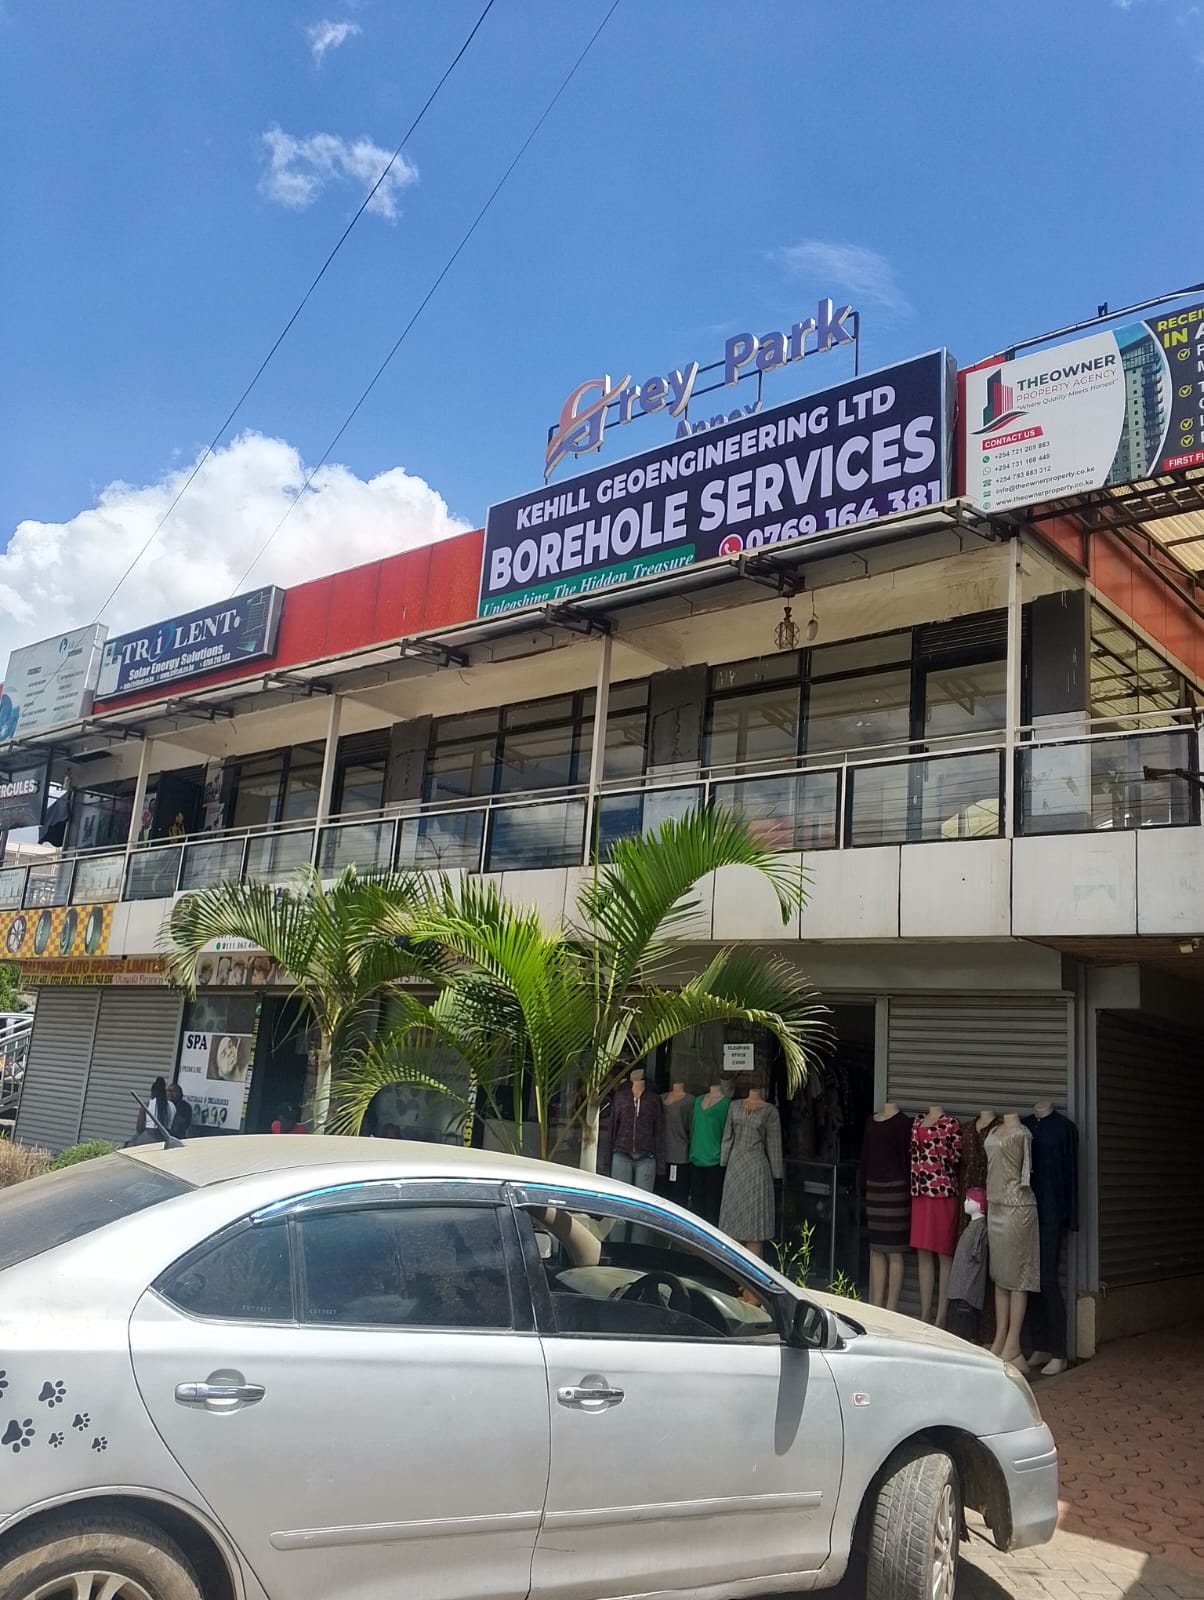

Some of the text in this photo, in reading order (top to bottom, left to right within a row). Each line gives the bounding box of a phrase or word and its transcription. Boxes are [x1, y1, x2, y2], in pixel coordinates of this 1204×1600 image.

[1158, 309, 1204, 332] RECEI
[1164, 327, 1188, 349] IN
[545, 297, 856, 479] Grey Park
[1016, 368, 1117, 402] PROPERTY AGENCY
[1017, 354, 1116, 391] THEOWNER
[1043, 393, 1067, 405] Quality
[1068, 387, 1089, 398] Meets
[984, 430, 1036, 448] CONTACT US
[516, 385, 896, 530] KEHILL GEOENGINEERING LTD
[1169, 454, 1195, 468] FIRST
[489, 416, 936, 591] BOREHOLE SERVICES
[746, 480, 941, 550] 0769 164 381
[483, 552, 694, 617] Unleashing The Hidden Treasure
[129, 665, 150, 681] Solar
[151, 656, 180, 675] Energy
[181, 644, 223, 666] Solutions
[67, 960, 89, 975] AUTO
[91, 959, 124, 975] SPARES
[186, 1034, 208, 1050] SPA
